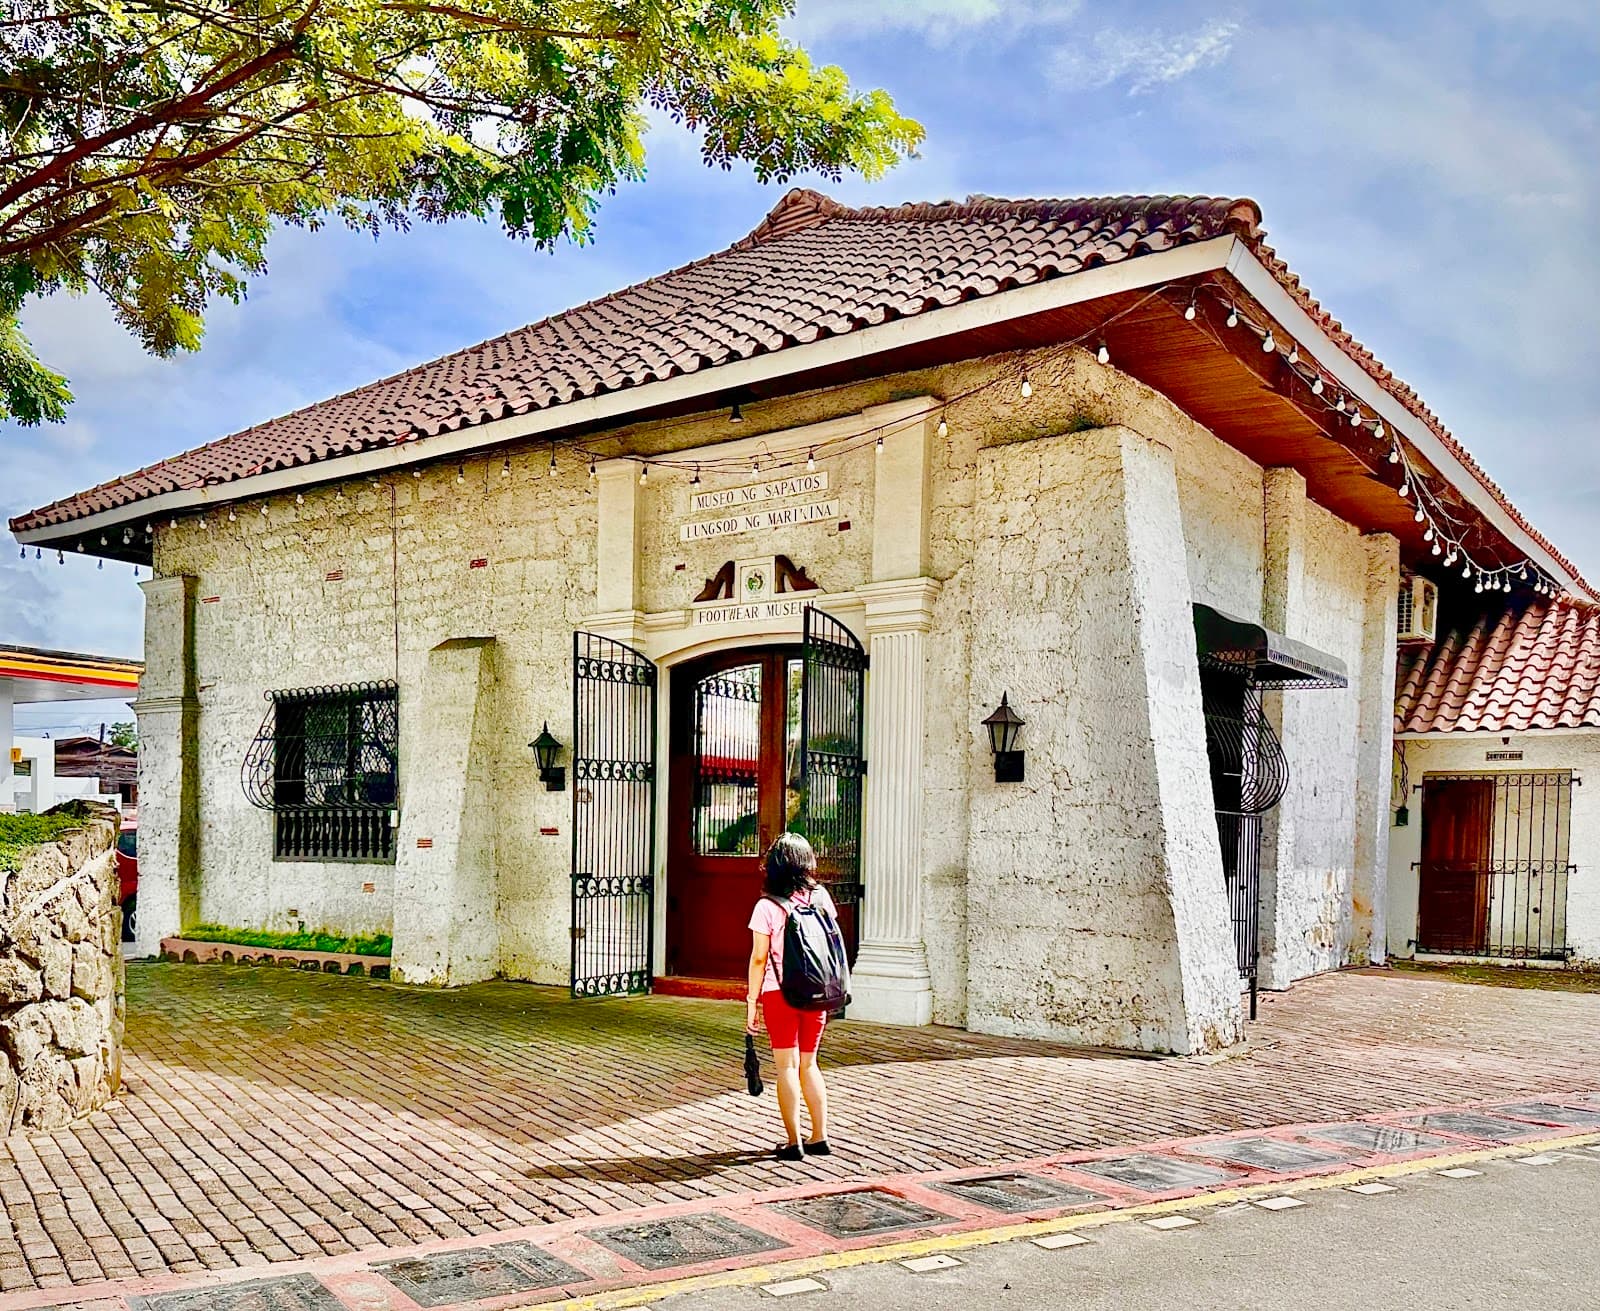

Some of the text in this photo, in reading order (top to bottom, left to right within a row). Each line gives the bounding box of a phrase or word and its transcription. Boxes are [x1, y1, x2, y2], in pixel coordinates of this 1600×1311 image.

[697, 476, 820, 509] MUSEO NG SAPATOS
[687, 504, 832, 539] LUNGSOD NG MARIKINA
[699, 605, 759, 624] FOOTWEAR
